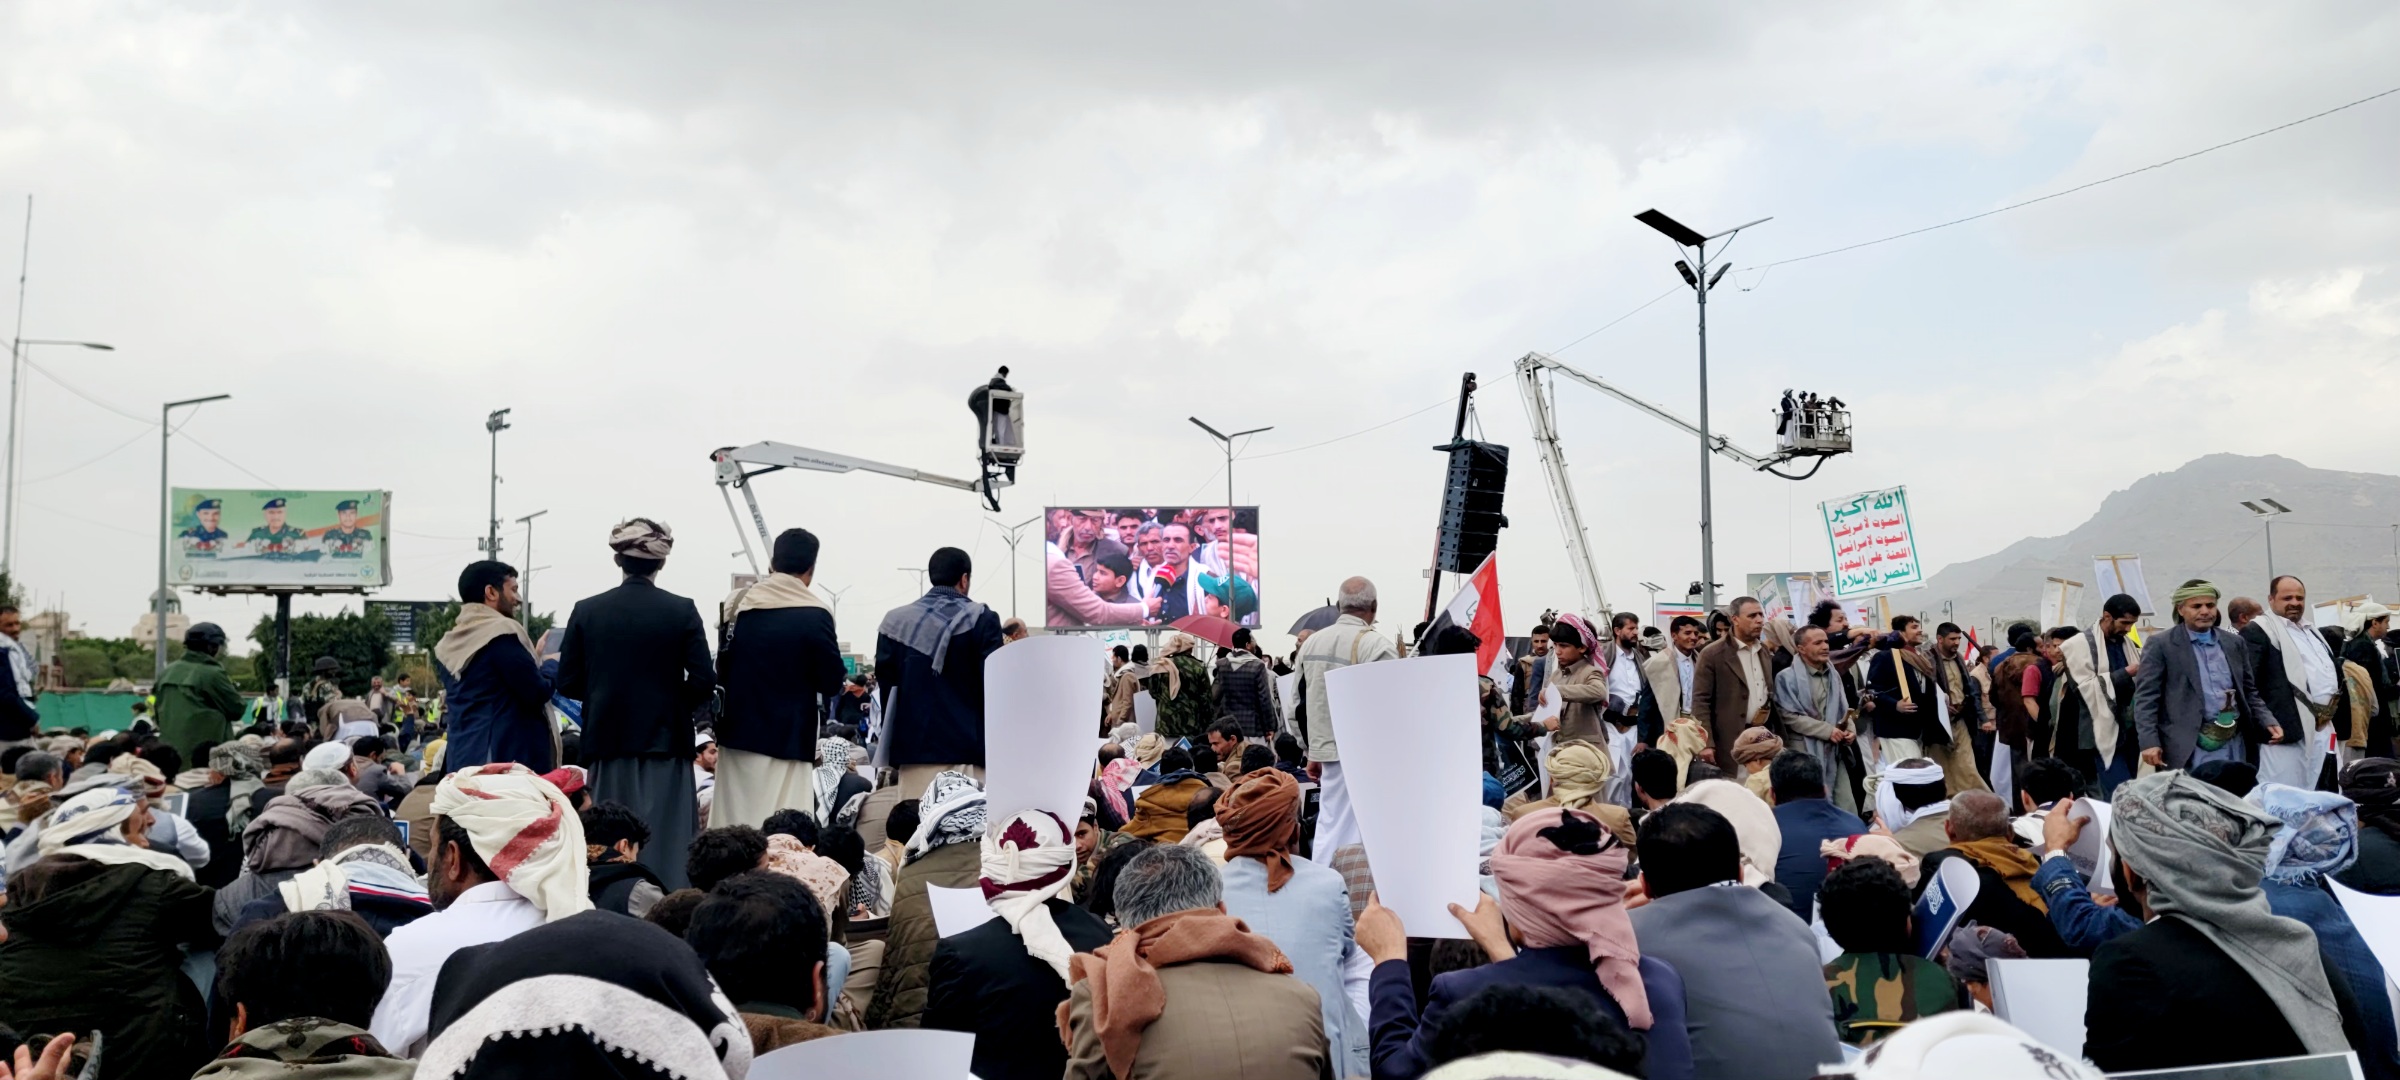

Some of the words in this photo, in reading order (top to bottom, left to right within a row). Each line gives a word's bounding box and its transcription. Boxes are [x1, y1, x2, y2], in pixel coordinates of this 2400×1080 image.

[1873, 490, 1901, 510] الله
[1872, 513, 1904, 530] الموت
[1875, 530, 1908, 547] الموت
[1868, 551, 1883, 567] على
[1886, 546, 1911, 560] اللعنة
[1839, 554, 1866, 572] اليهود
[1841, 568, 1878, 591] للإسلام
[1881, 562, 1915, 585] النصر
